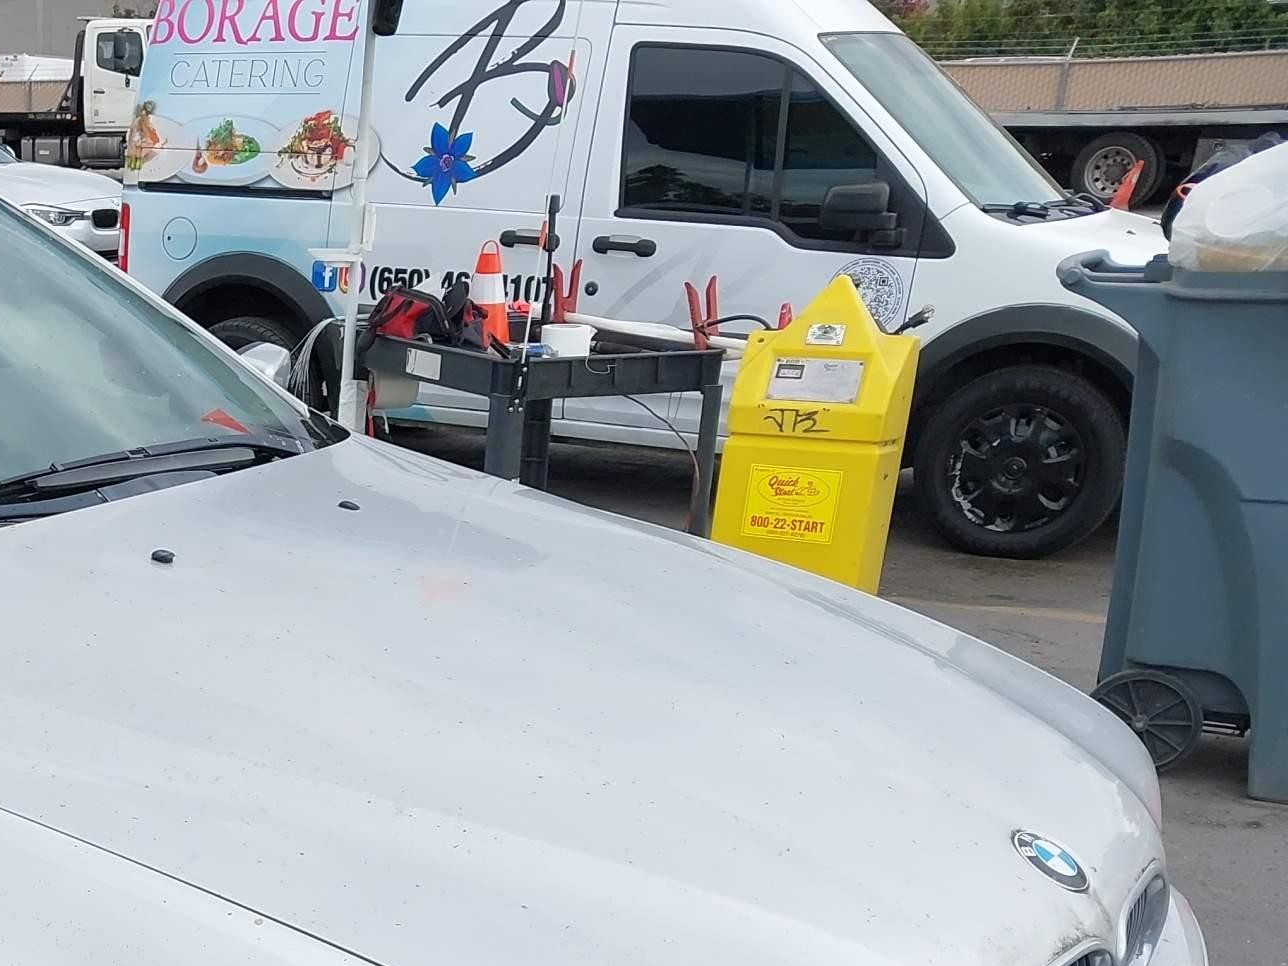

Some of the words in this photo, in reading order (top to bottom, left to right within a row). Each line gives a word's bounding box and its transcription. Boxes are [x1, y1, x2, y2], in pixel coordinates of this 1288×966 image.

[151, 0, 359, 45] BORAGE
[170, 59, 325, 88] CATERING
[768, 475, 800, 489] Quick
